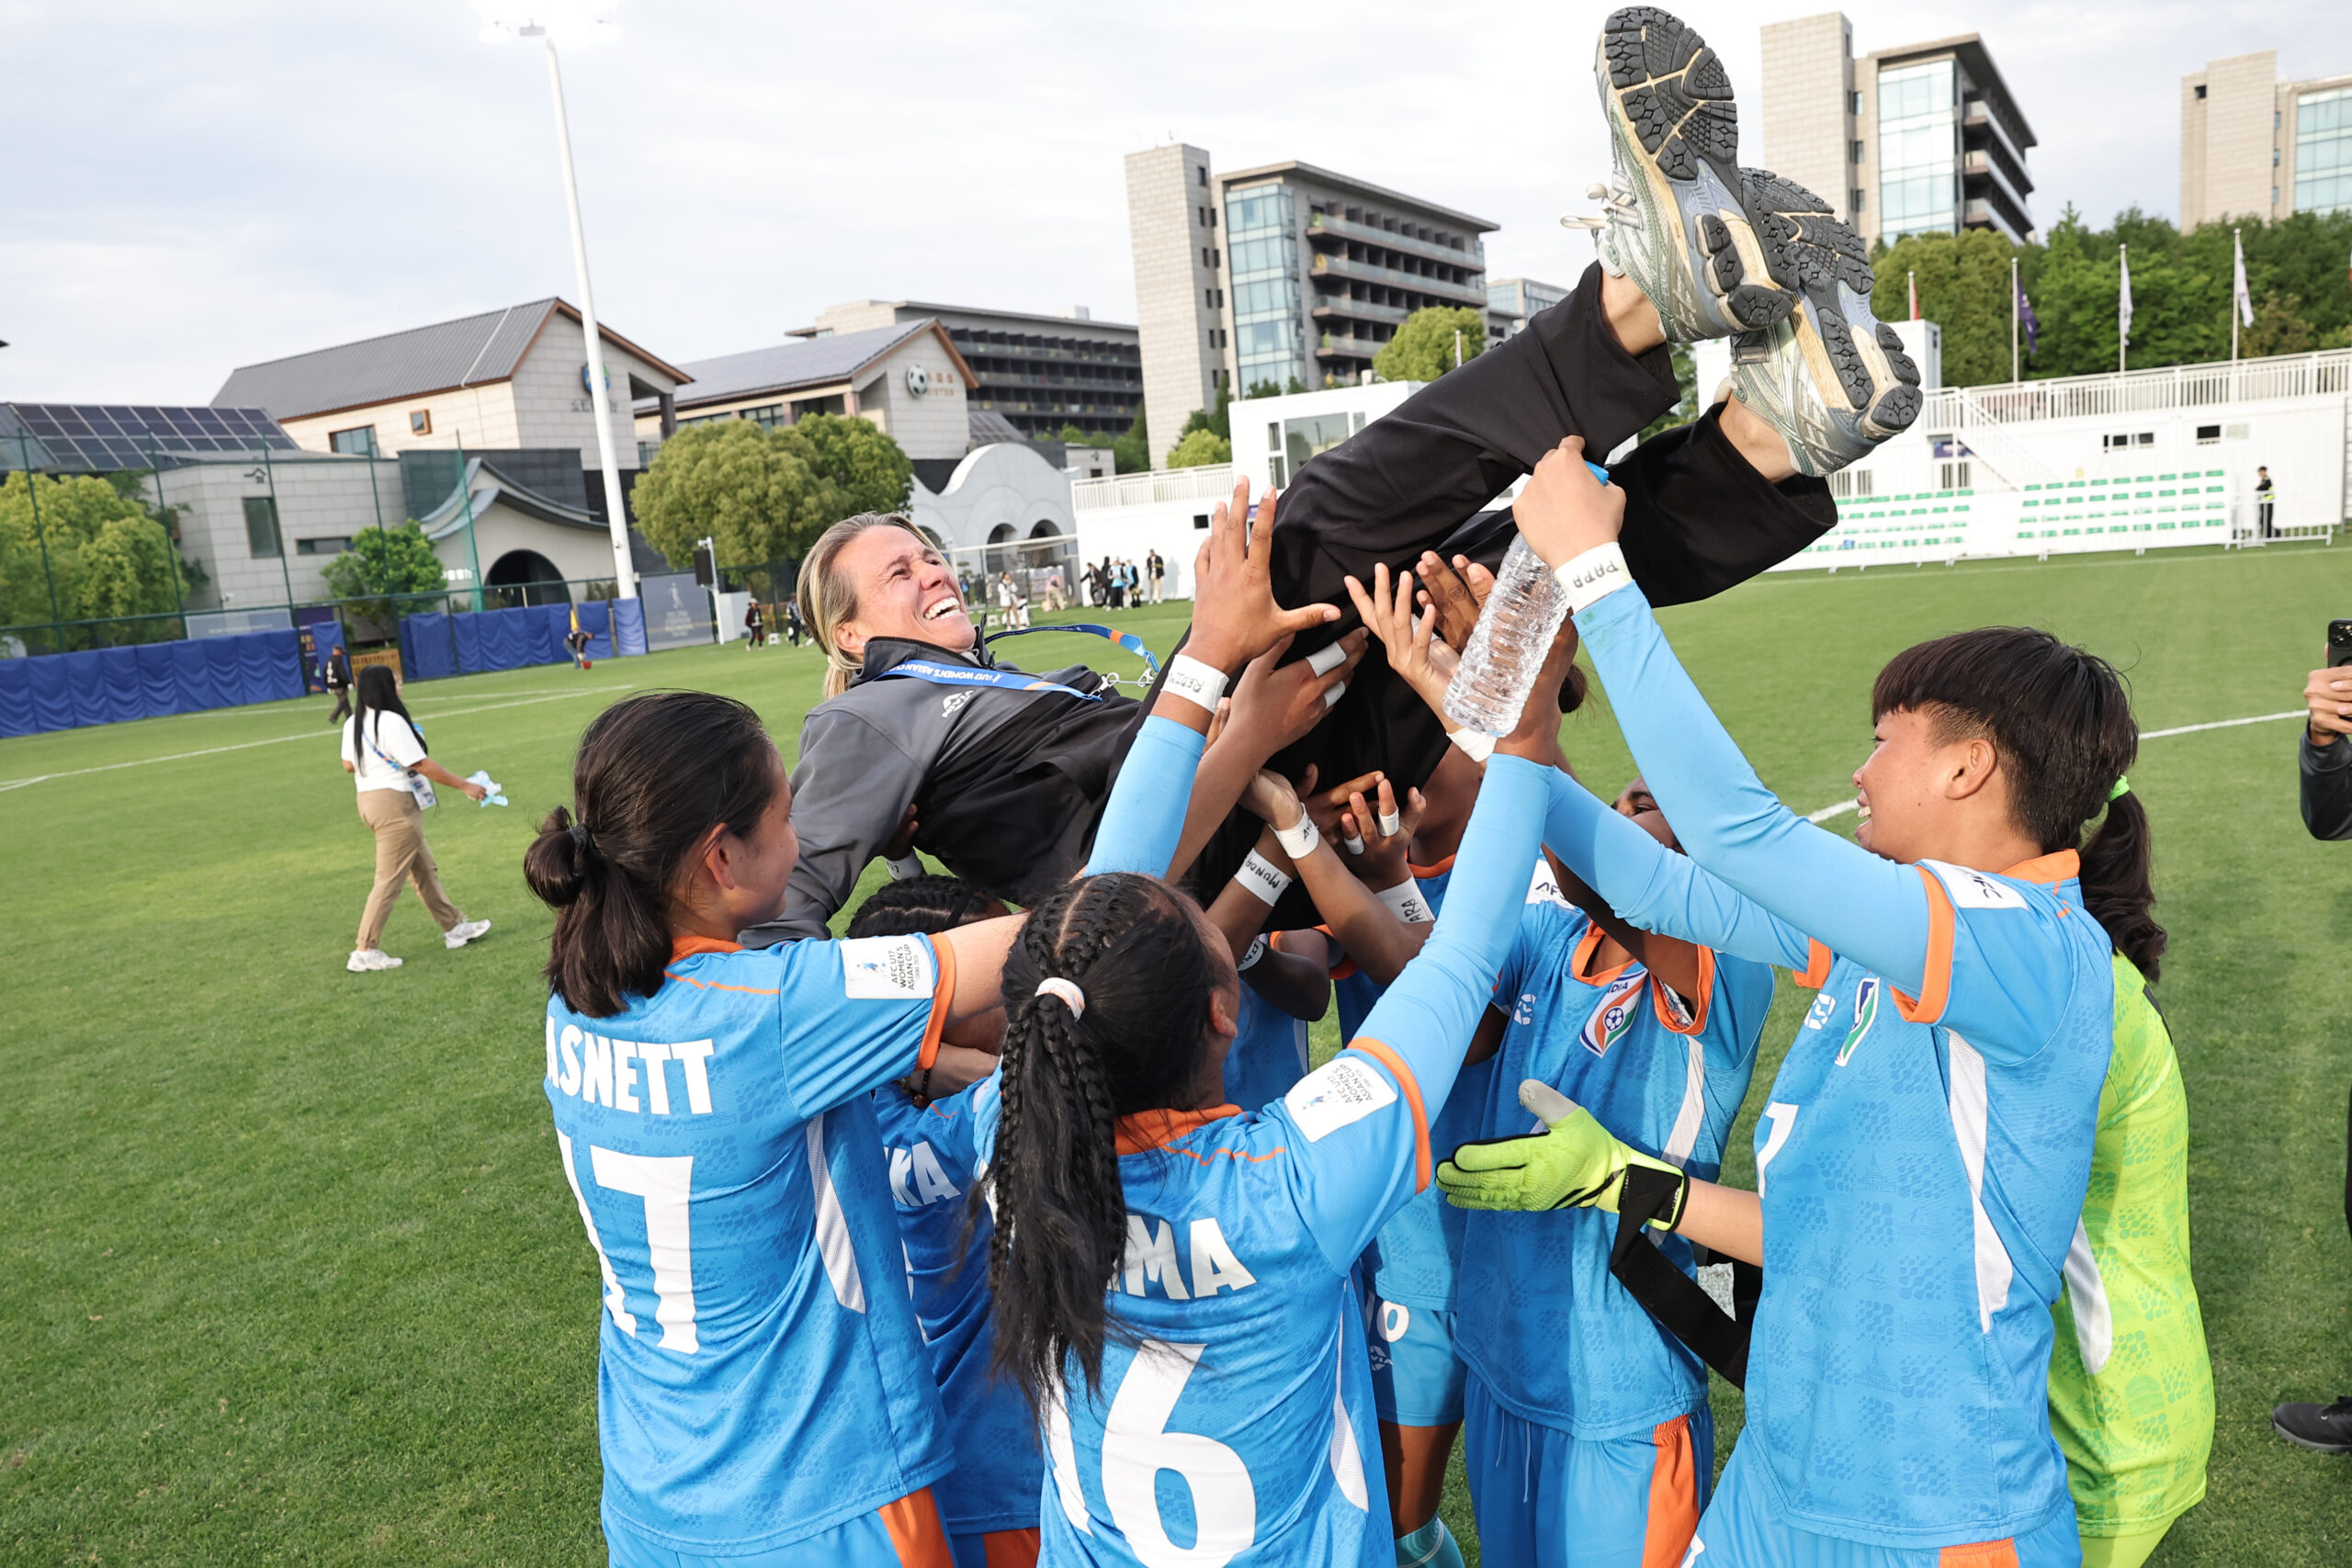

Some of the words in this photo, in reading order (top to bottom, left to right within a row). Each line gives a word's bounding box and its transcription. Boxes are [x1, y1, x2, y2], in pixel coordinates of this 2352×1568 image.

[1572, 559, 1619, 589] PAPA
[907, 664, 934, 675] ASIAN
[1244, 856, 1281, 889] MUNDA
[888, 950, 896, 964] U17
[896, 946, 907, 988] WOMEN'S
[890, 965, 899, 984] AFC
[907, 962, 915, 990] ASIAN
[1340, 1064, 1355, 1078] CUP
[1337, 1087, 1353, 1103] AFC
[1353, 1077, 1374, 1100] ASIAN
[884, 1140, 962, 1207] KA
[1106, 1214, 1257, 1301] MA
